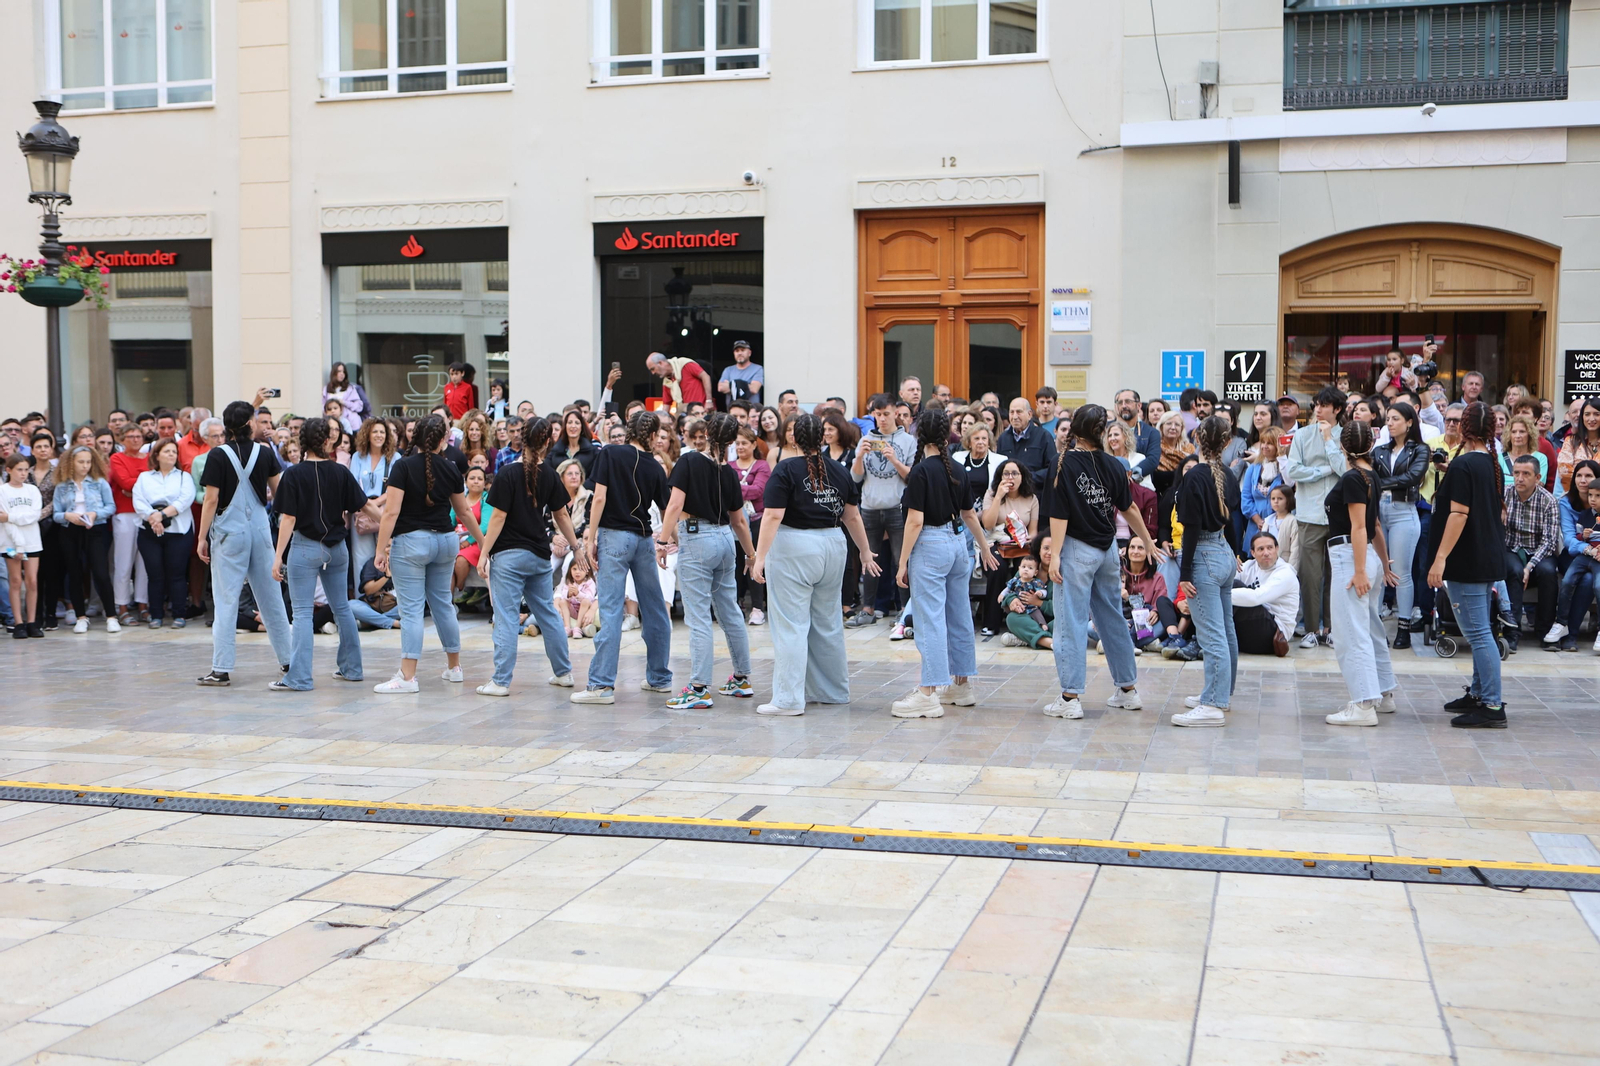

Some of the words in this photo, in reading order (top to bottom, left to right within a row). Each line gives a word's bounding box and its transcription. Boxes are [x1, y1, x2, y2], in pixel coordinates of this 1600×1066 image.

[942, 157, 957, 168] 12
[641, 230, 739, 249] Santander
[95, 250, 177, 267] Santander
[1173, 355, 1194, 378] H
[1229, 352, 1261, 382] V
[382, 409, 400, 417] ALL
[403, 409, 424, 418] YOU
